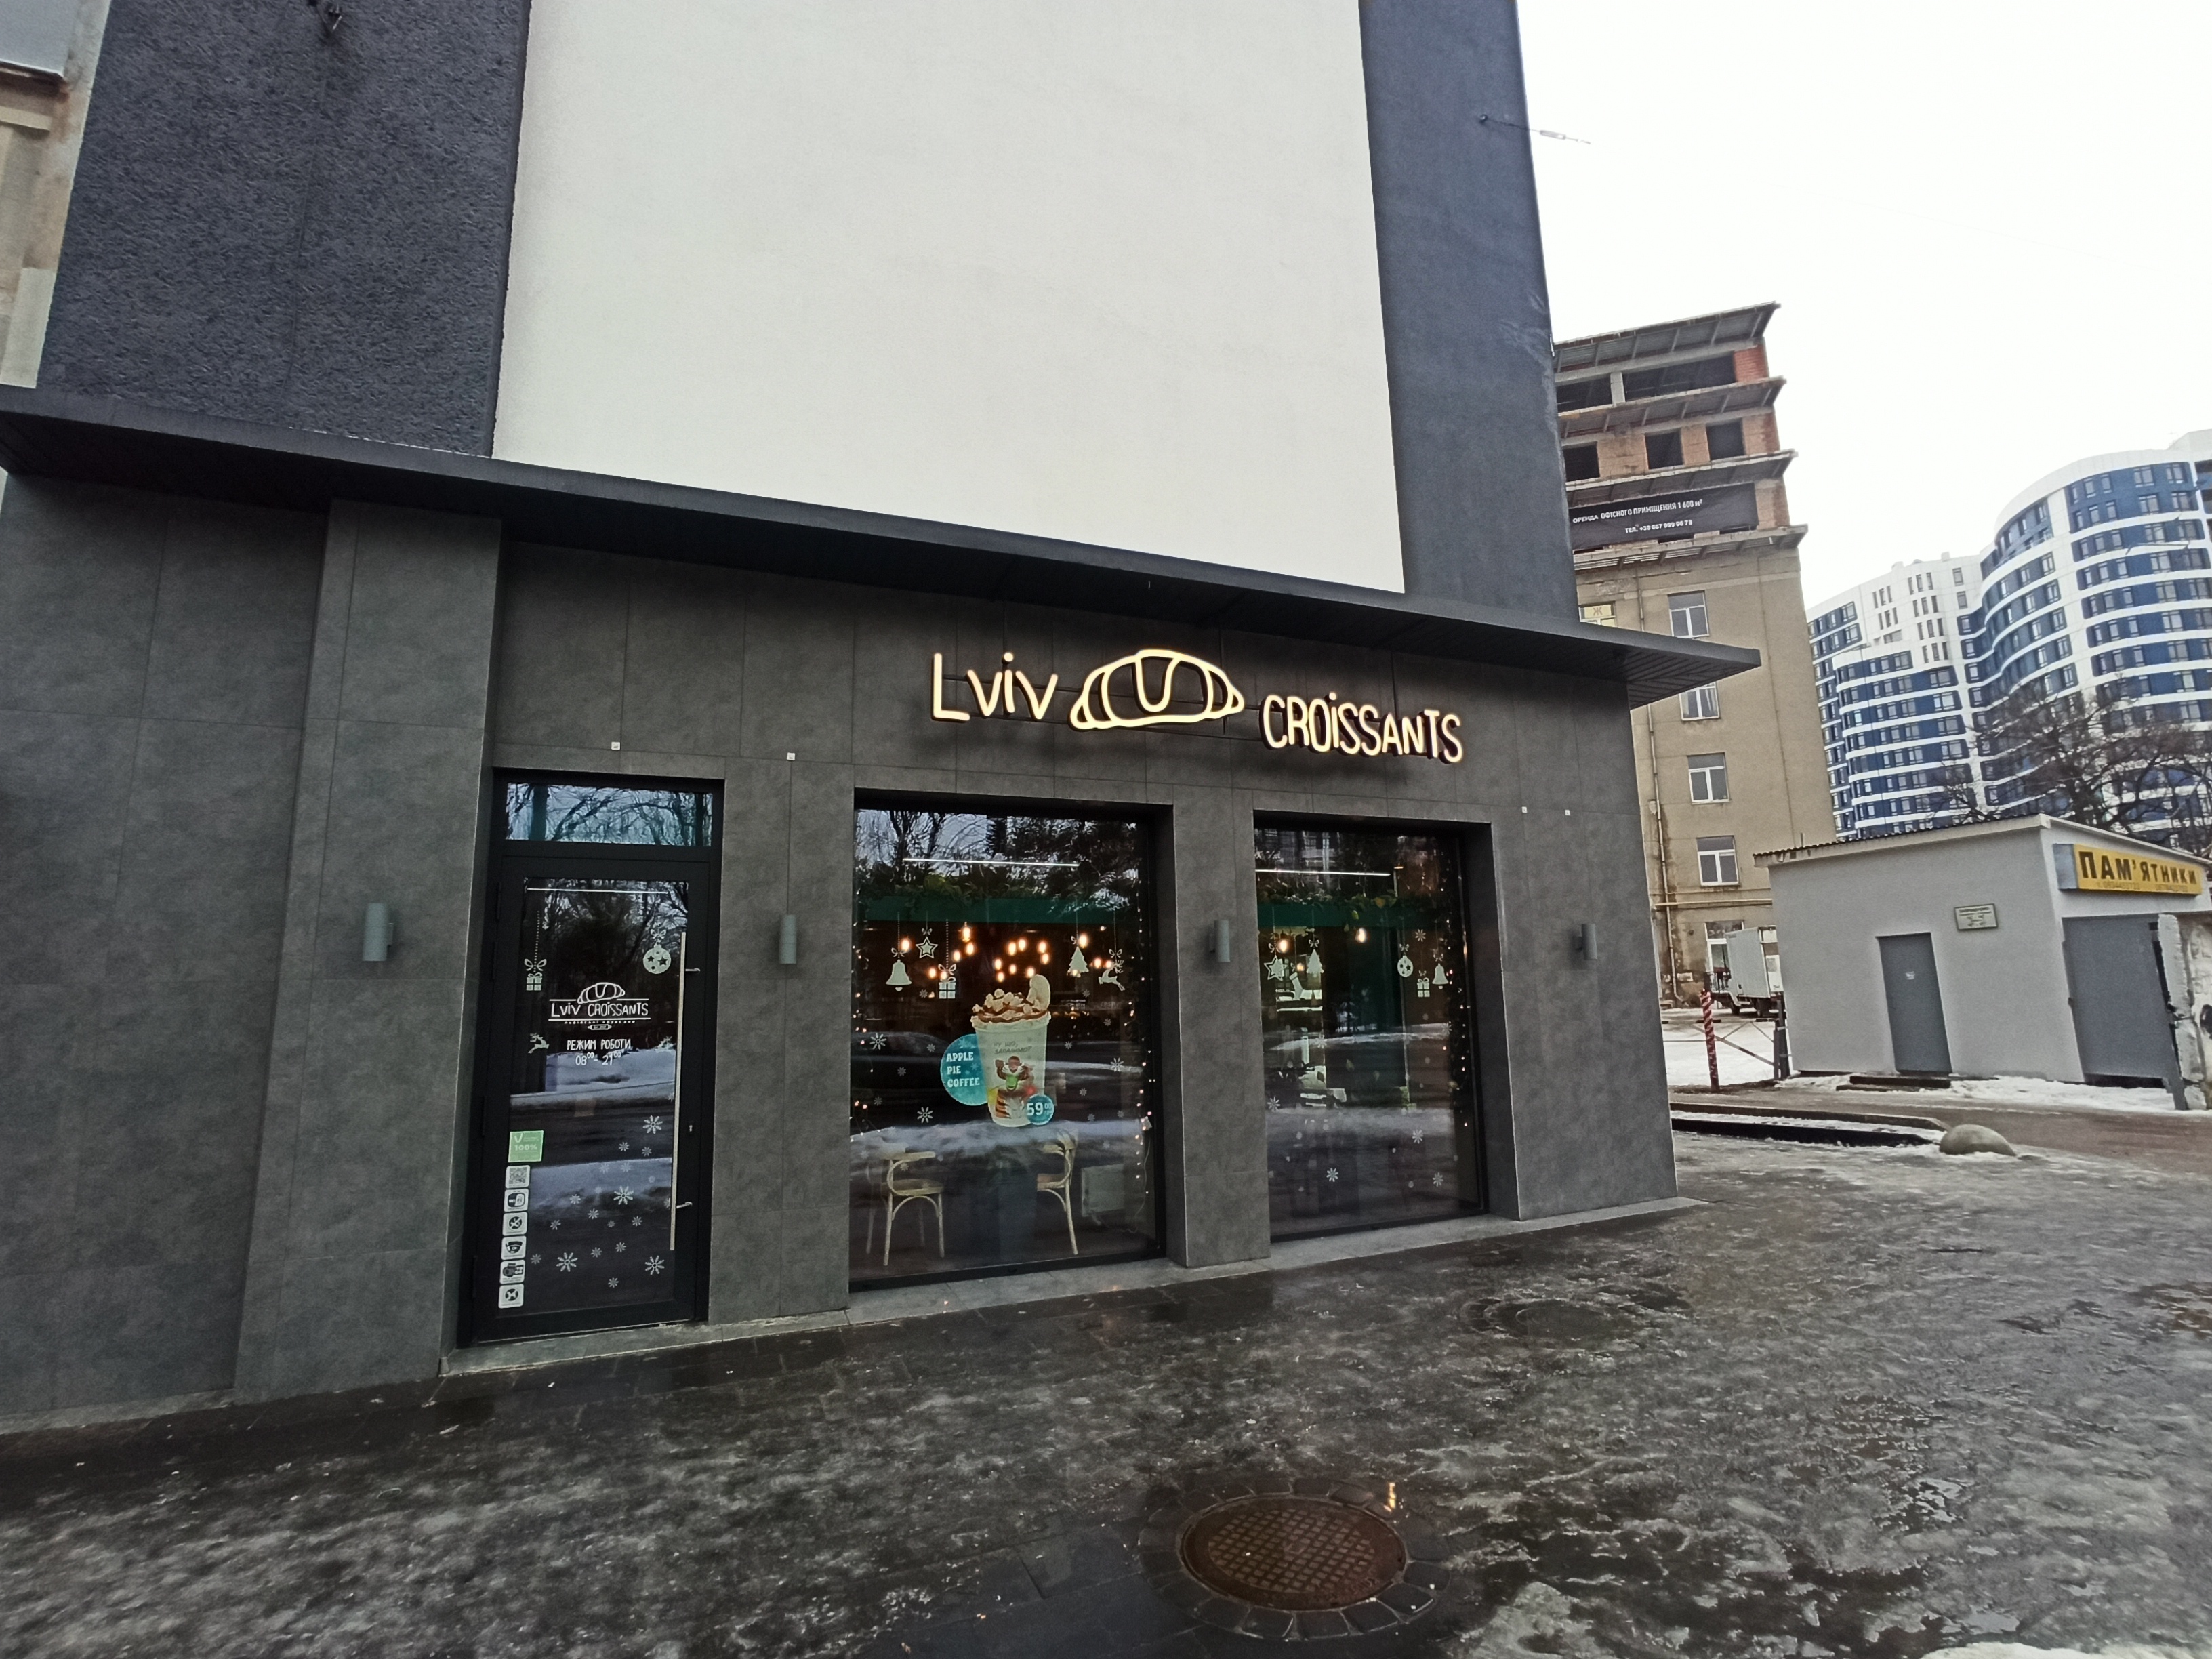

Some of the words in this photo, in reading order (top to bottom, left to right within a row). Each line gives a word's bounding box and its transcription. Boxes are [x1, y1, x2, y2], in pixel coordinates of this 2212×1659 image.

[1572, 514, 1599, 523] ОРЕНДА
[1601, 508, 1633, 520] ОФІСНОГО
[1633, 501, 1677, 514] ПРИМІЩЕННЯ
[1677, 501, 1681, 509] 1
[2078, 851, 2197, 884] ПАМ'ЯТНИКИ
[567, 1039, 596, 1050] РЕЖИМ
[600, 1038, 632, 1050] РОБОТИ
[946, 1052, 974, 1063] APPLE
[947, 1065, 962, 1076] PIE
[947, 1077, 980, 1088] COFFEE
